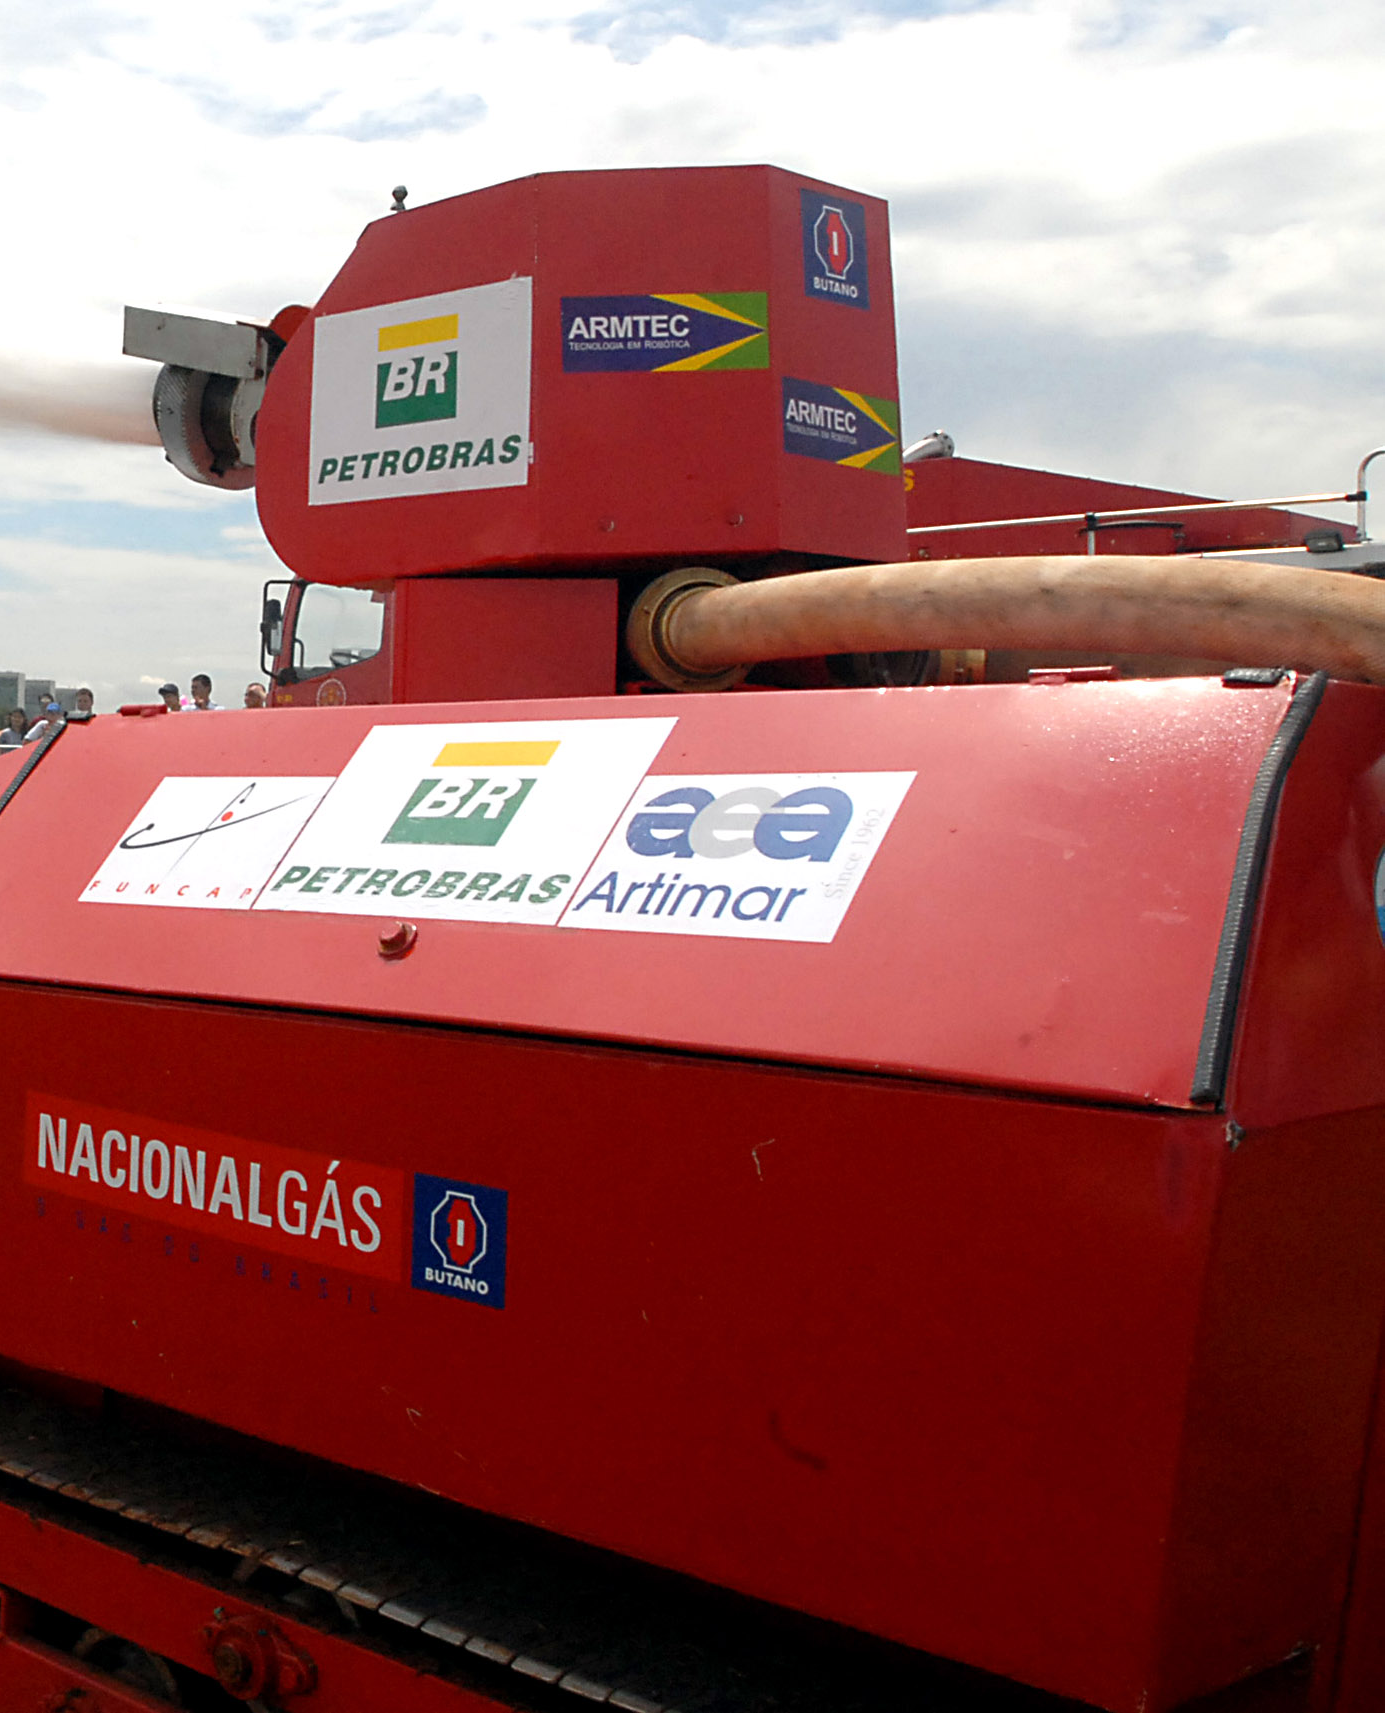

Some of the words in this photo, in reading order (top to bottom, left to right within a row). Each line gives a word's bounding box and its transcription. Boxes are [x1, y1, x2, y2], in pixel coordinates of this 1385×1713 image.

[813, 276, 859, 299] BUTANO
[568, 314, 690, 340] ARMTEC
[569, 341, 624, 351] TECNOLOGIA
[627, 340, 641, 350] EM
[382, 353, 450, 402] BR
[786, 398, 857, 434] ARMTEC
[318, 434, 522, 485] PETROBRAS
[407, 778, 523, 819] BR
[823, 853, 864, 900] Since
[850, 808, 886, 846] 1962
[270, 865, 572, 904] PETROBRAS
[572, 871, 808, 923] Artimar
[424, 1266, 490, 1296] BUTANO
